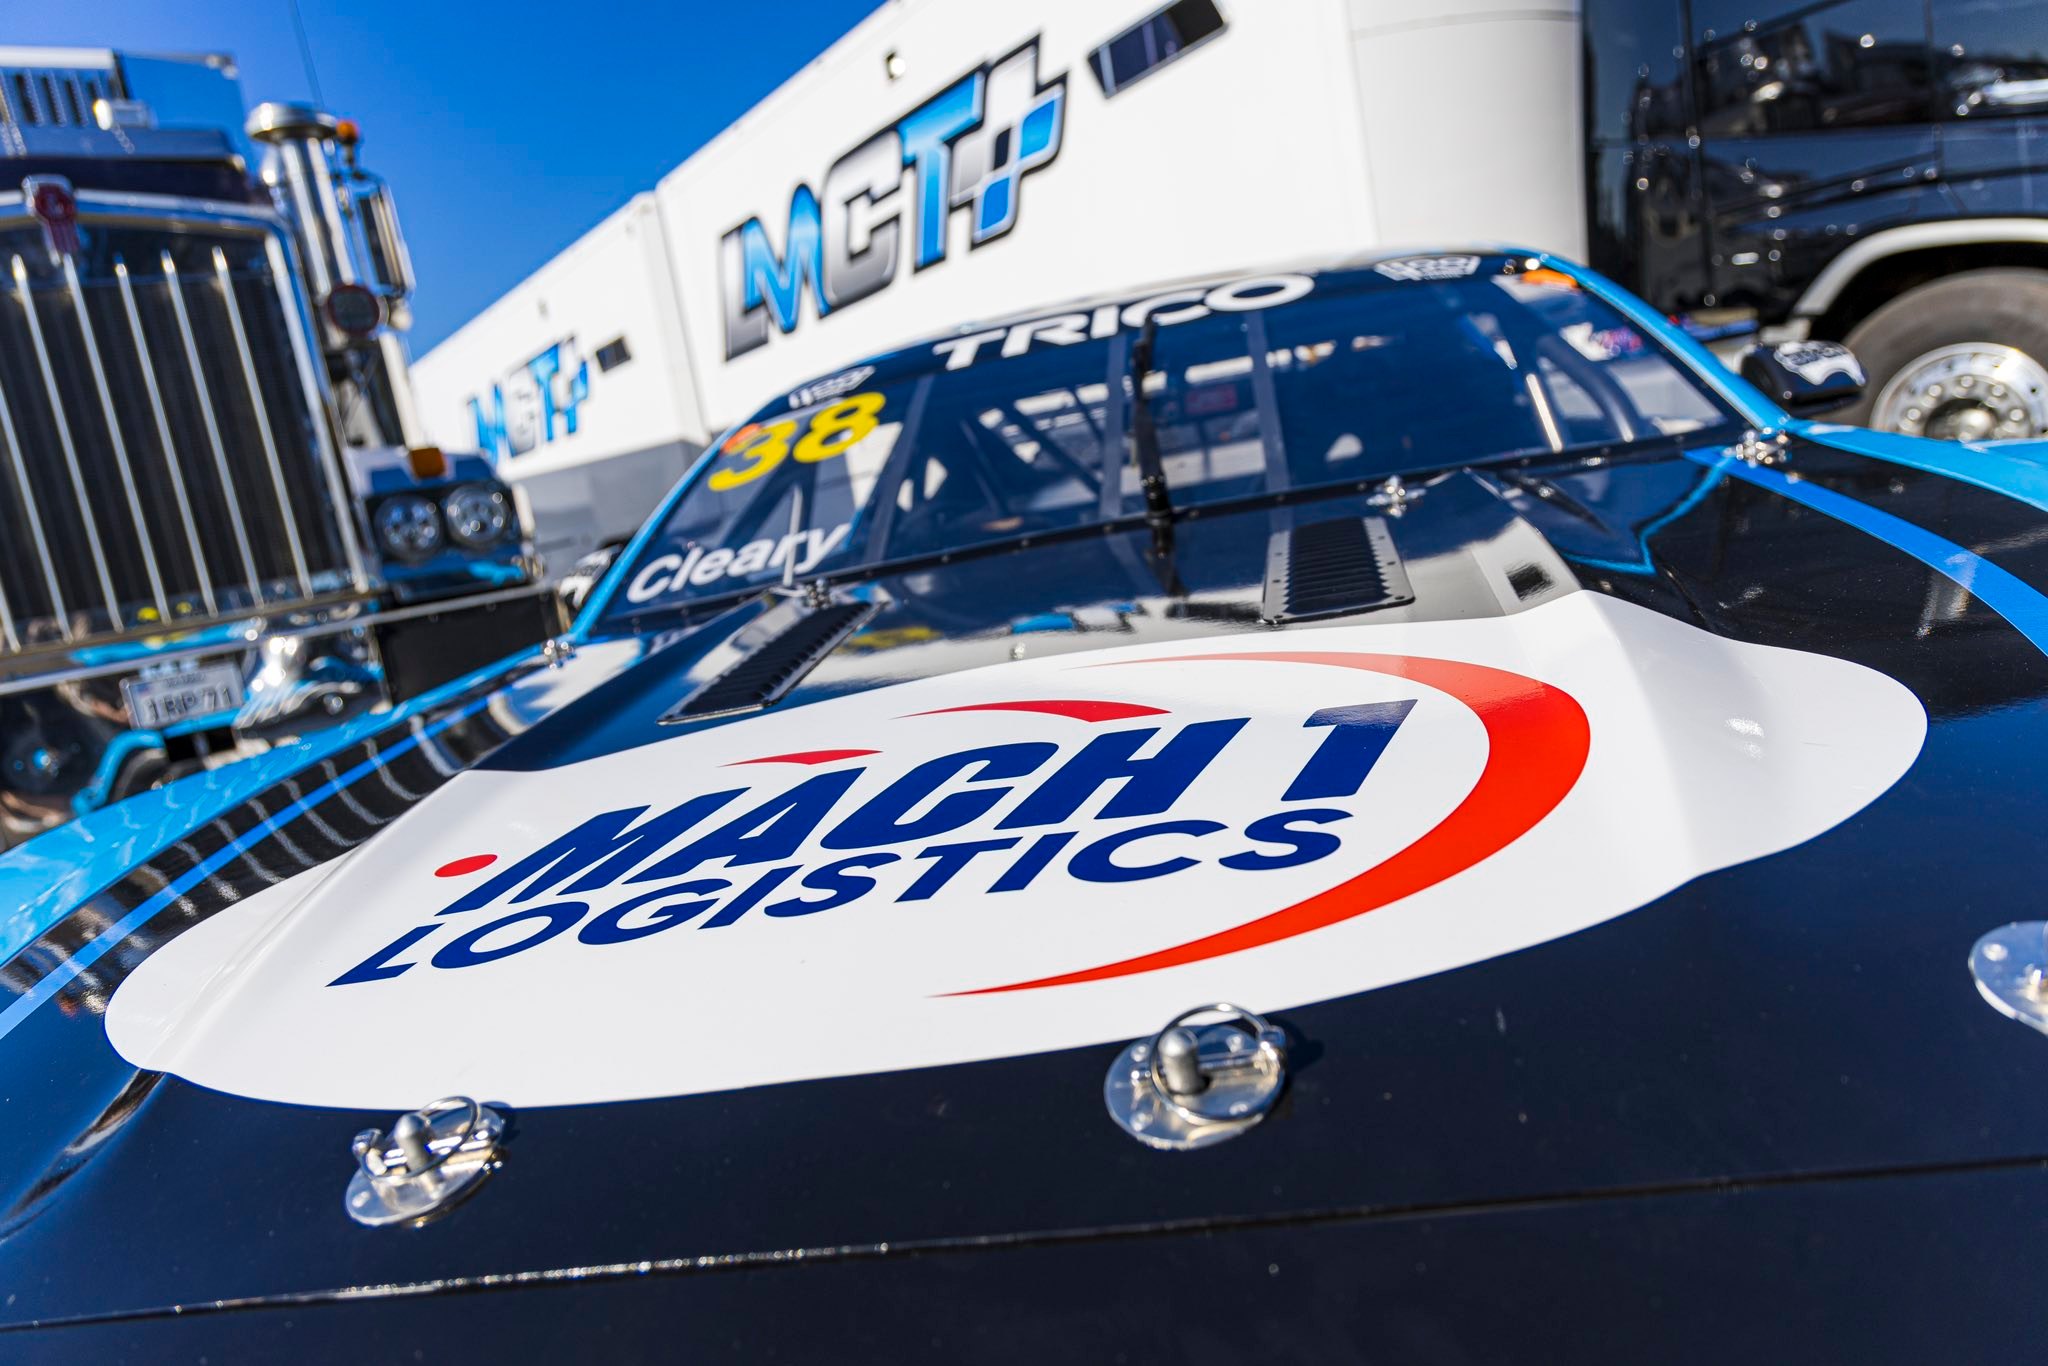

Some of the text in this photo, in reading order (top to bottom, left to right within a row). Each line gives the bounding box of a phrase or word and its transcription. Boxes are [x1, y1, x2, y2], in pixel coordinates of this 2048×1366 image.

[932, 274, 1315, 371] TRICO
[707, 391, 887, 492] 38
[626, 522, 852, 603] Cleary
[437, 699, 1418, 917] MACH 1
[330, 808, 1351, 987] LOGISTICS
